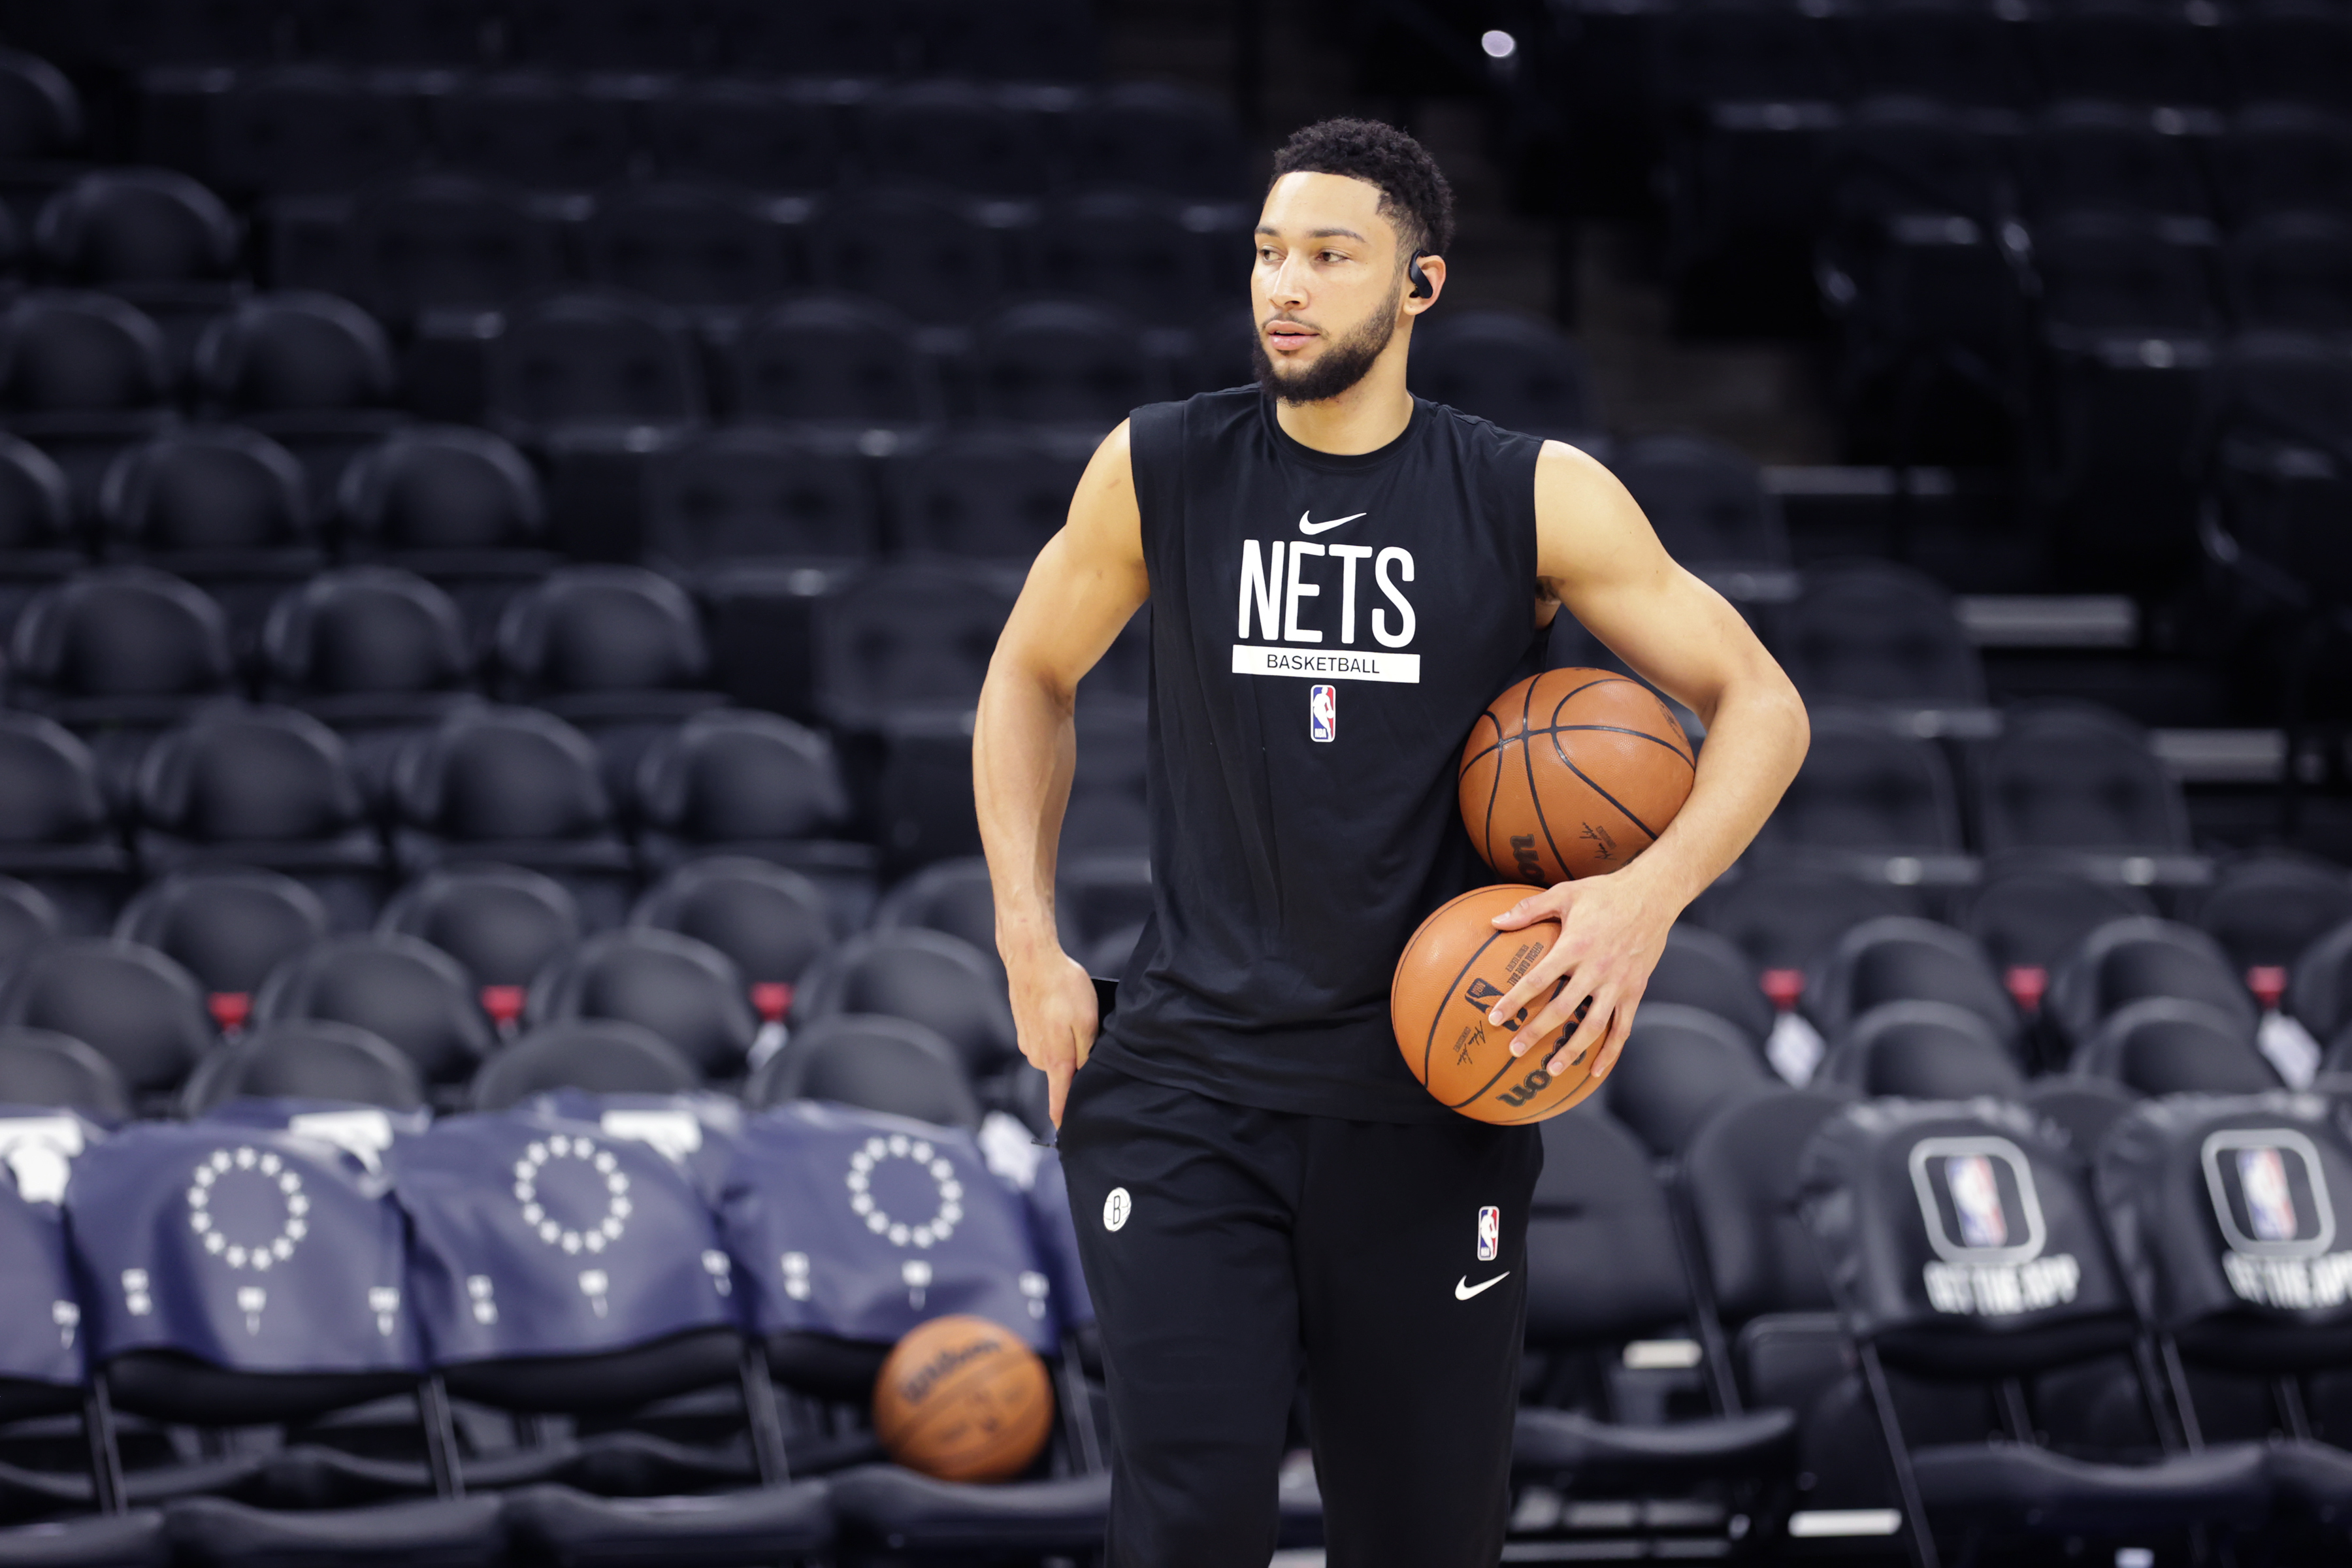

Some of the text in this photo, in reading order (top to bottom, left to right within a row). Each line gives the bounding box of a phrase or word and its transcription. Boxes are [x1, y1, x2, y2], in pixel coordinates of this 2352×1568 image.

[1239, 539, 1416, 648] NETS
[1267, 654, 1380, 674] BASKETBALL
[1315, 728, 1327, 738] NBA
[1507, 942, 1544, 987] OFFICIAL GAME BALL
[1471, 981, 1486, 996] NBA
[1113, 1195, 1120, 1225] B
